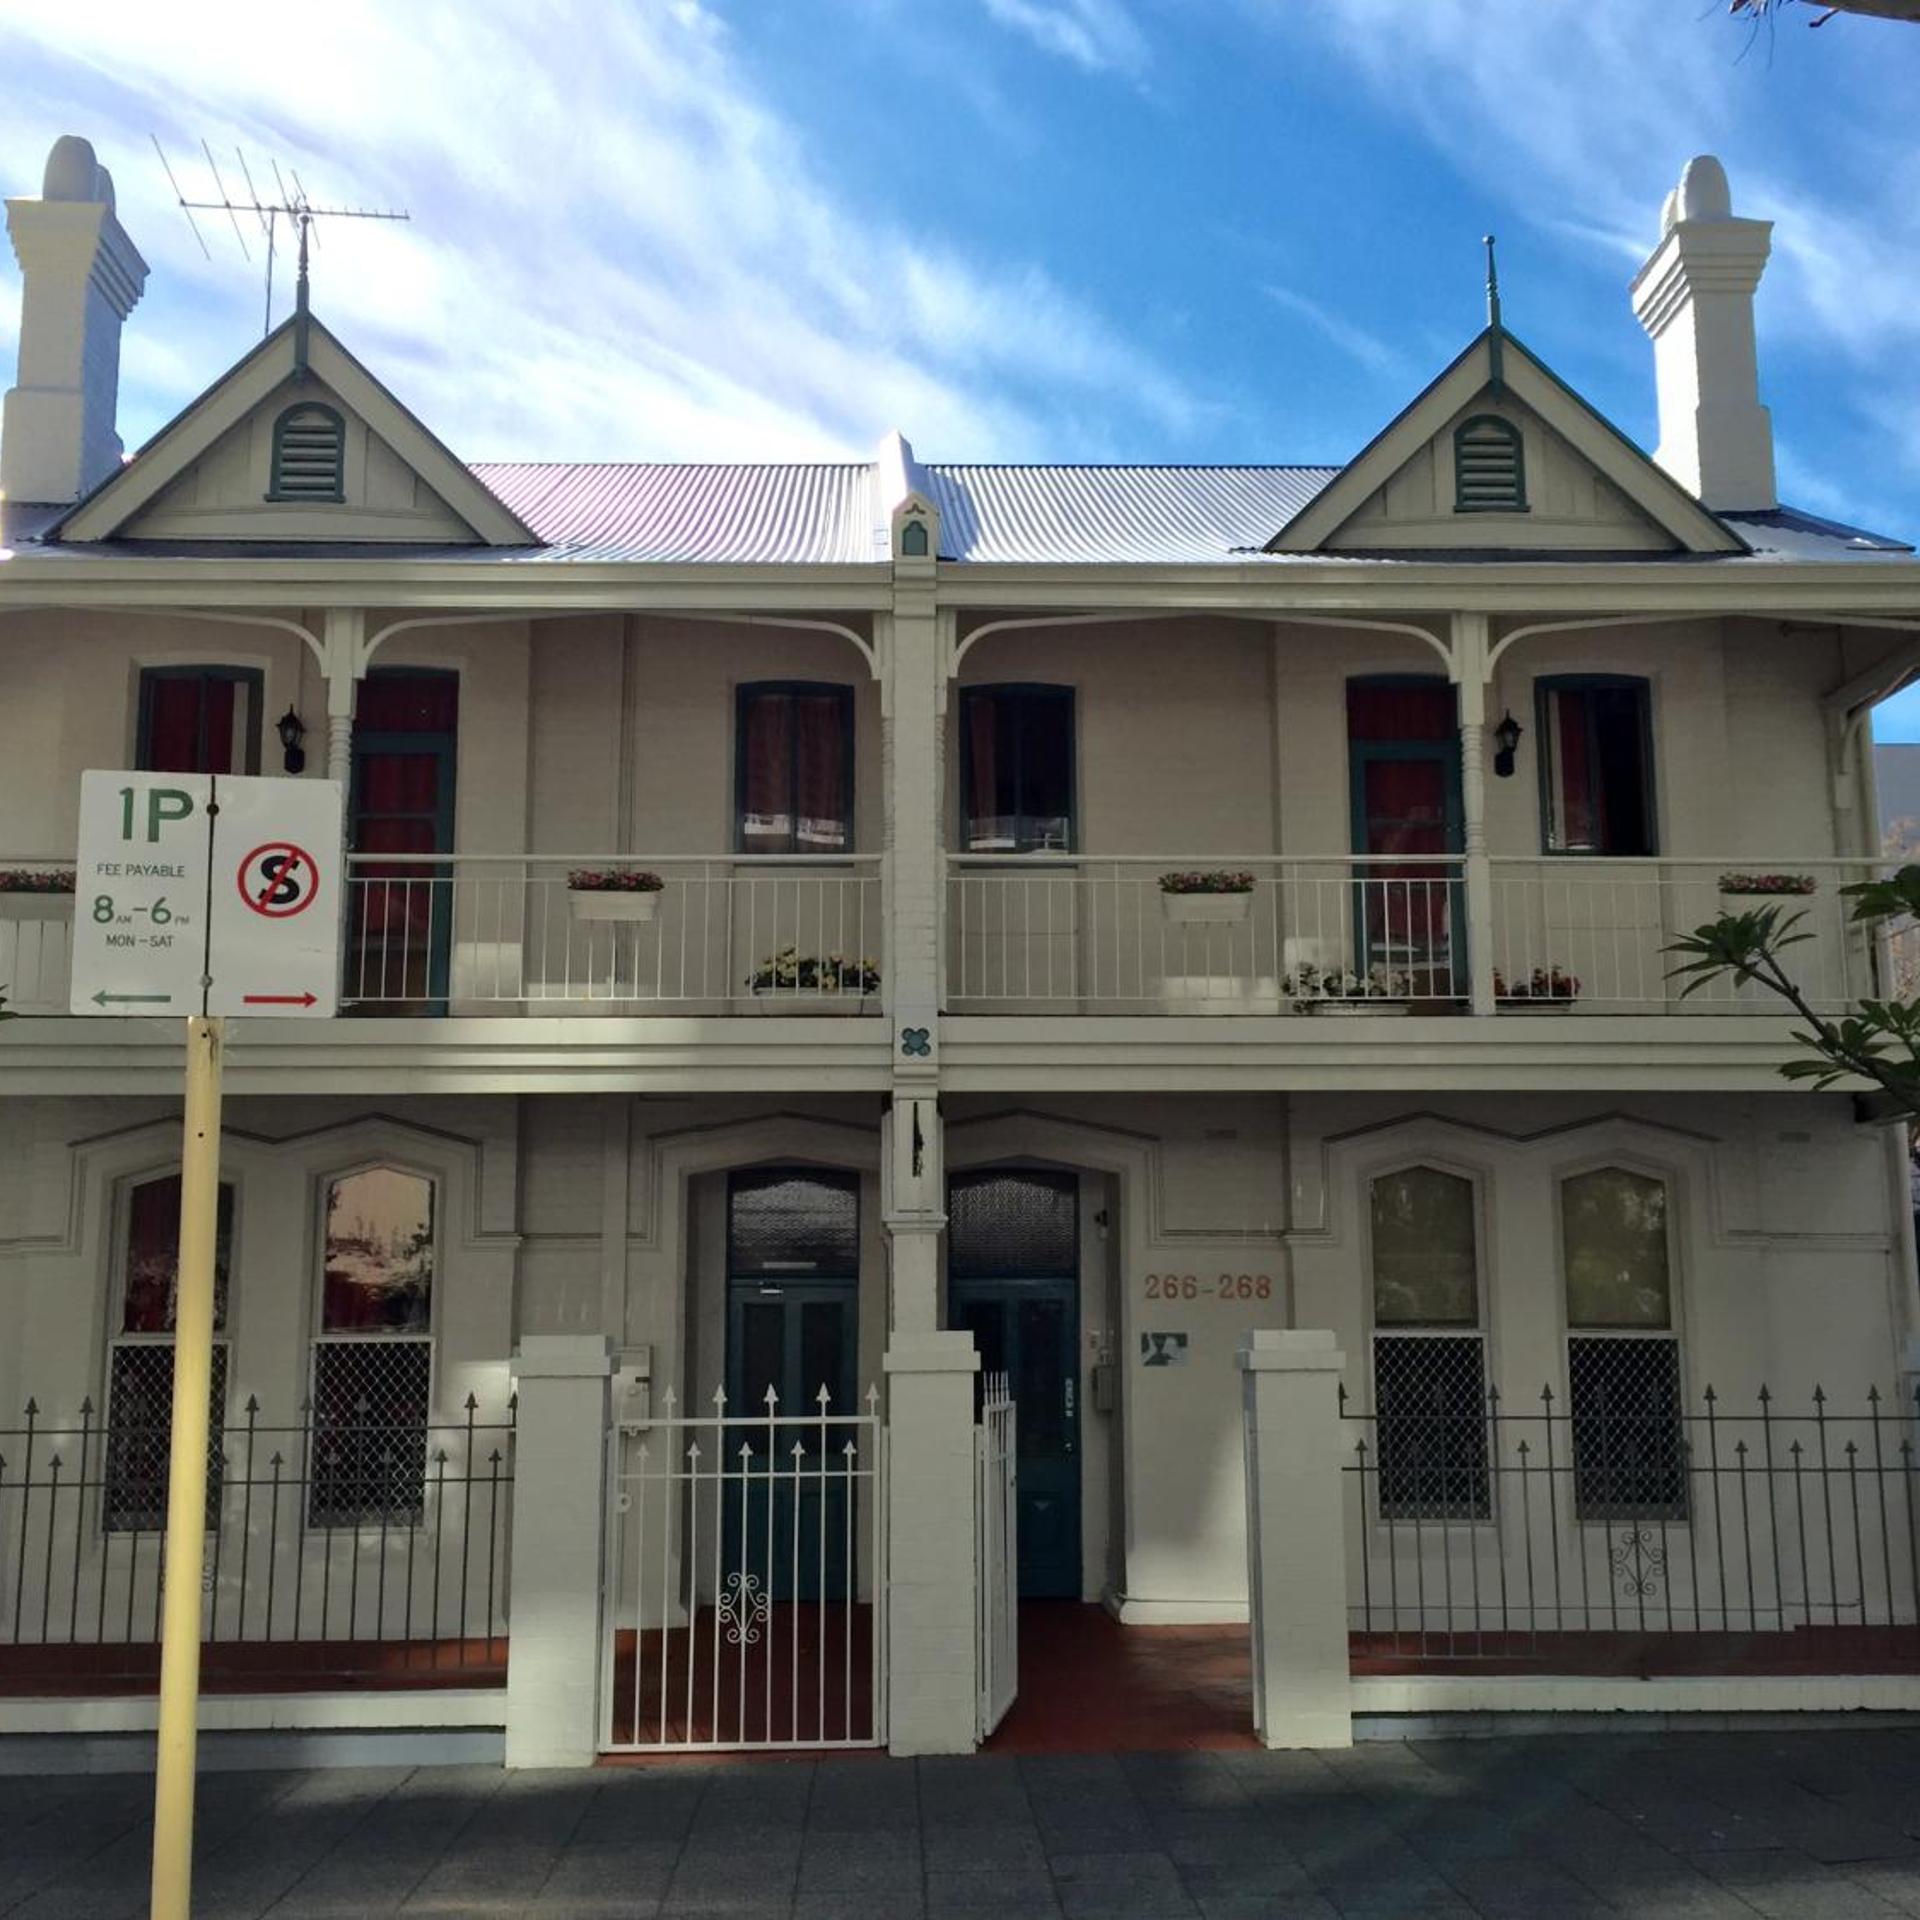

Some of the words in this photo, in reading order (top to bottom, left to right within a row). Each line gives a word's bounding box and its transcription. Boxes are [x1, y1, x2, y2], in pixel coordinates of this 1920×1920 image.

[119, 787, 194, 842] 1P
[96, 863, 122, 876] FEE
[125, 863, 185, 878] PAYABLE
